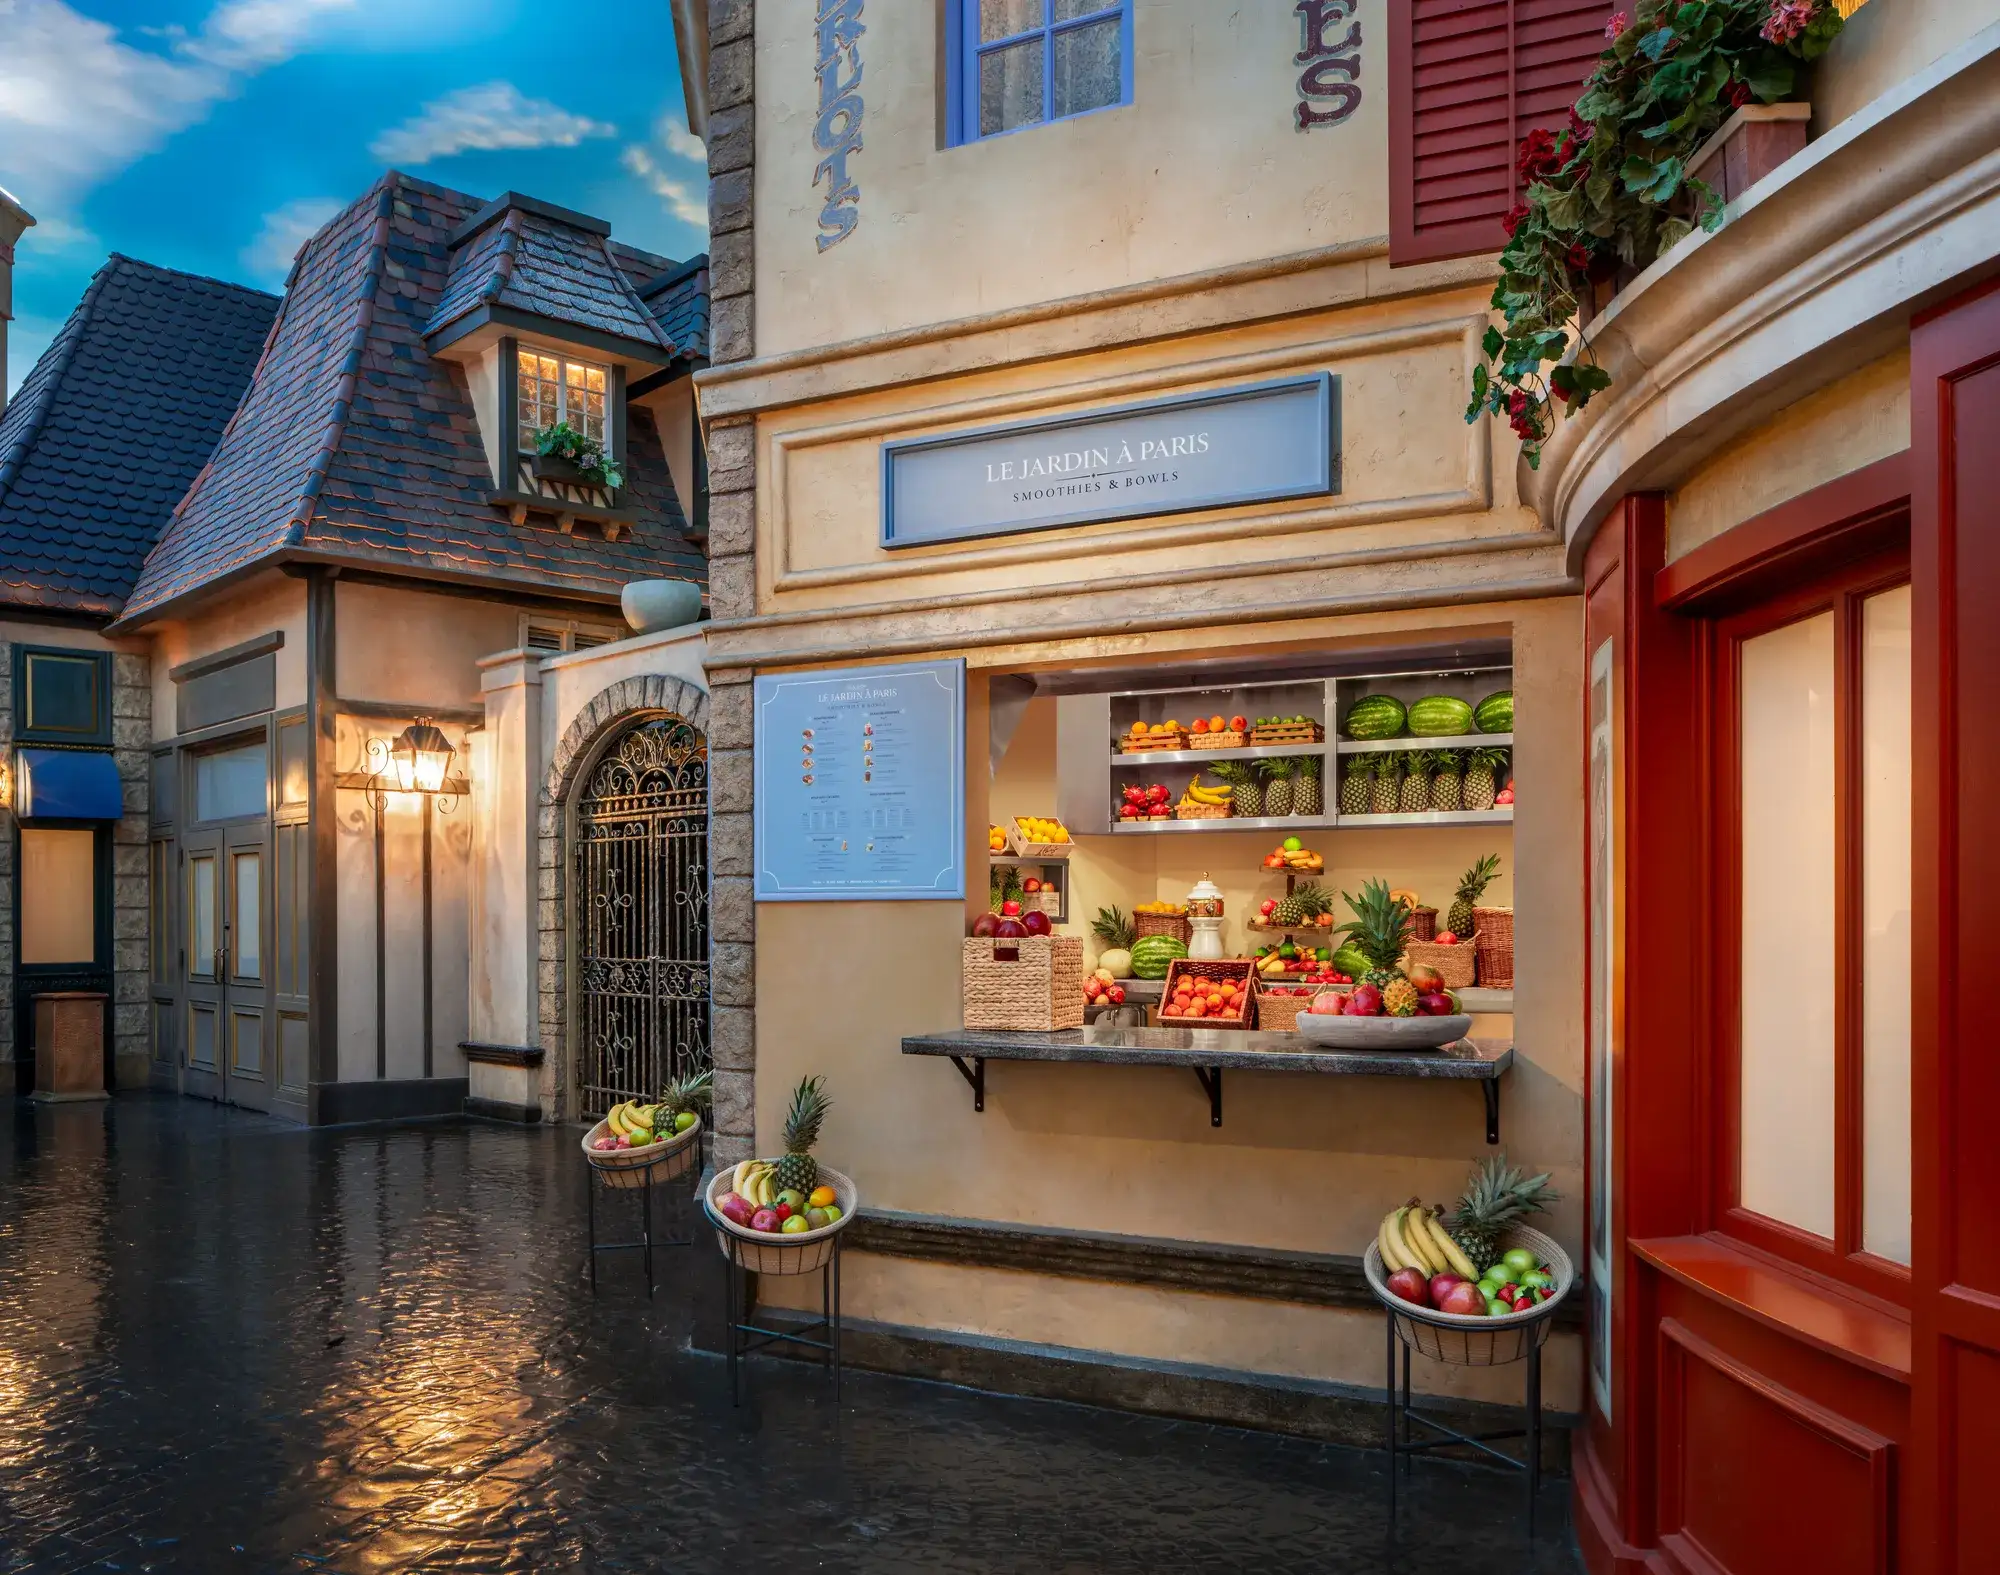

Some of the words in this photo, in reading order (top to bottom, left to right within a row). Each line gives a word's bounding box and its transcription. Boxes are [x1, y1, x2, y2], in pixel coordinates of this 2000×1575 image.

[986, 461, 1014, 483] LE
[1019, 447, 1109, 480] JARDIN
[1116, 439, 1134, 464] À
[1140, 432, 1209, 461] PARIS
[1013, 481, 1101, 503] SMOOTHIES
[1108, 479, 1119, 490] &
[1125, 470, 1179, 488] BOWLS
[818, 693, 828, 703] LE
[830, 691, 863, 702] JARDIN
[873, 688, 898, 699] PARIS
